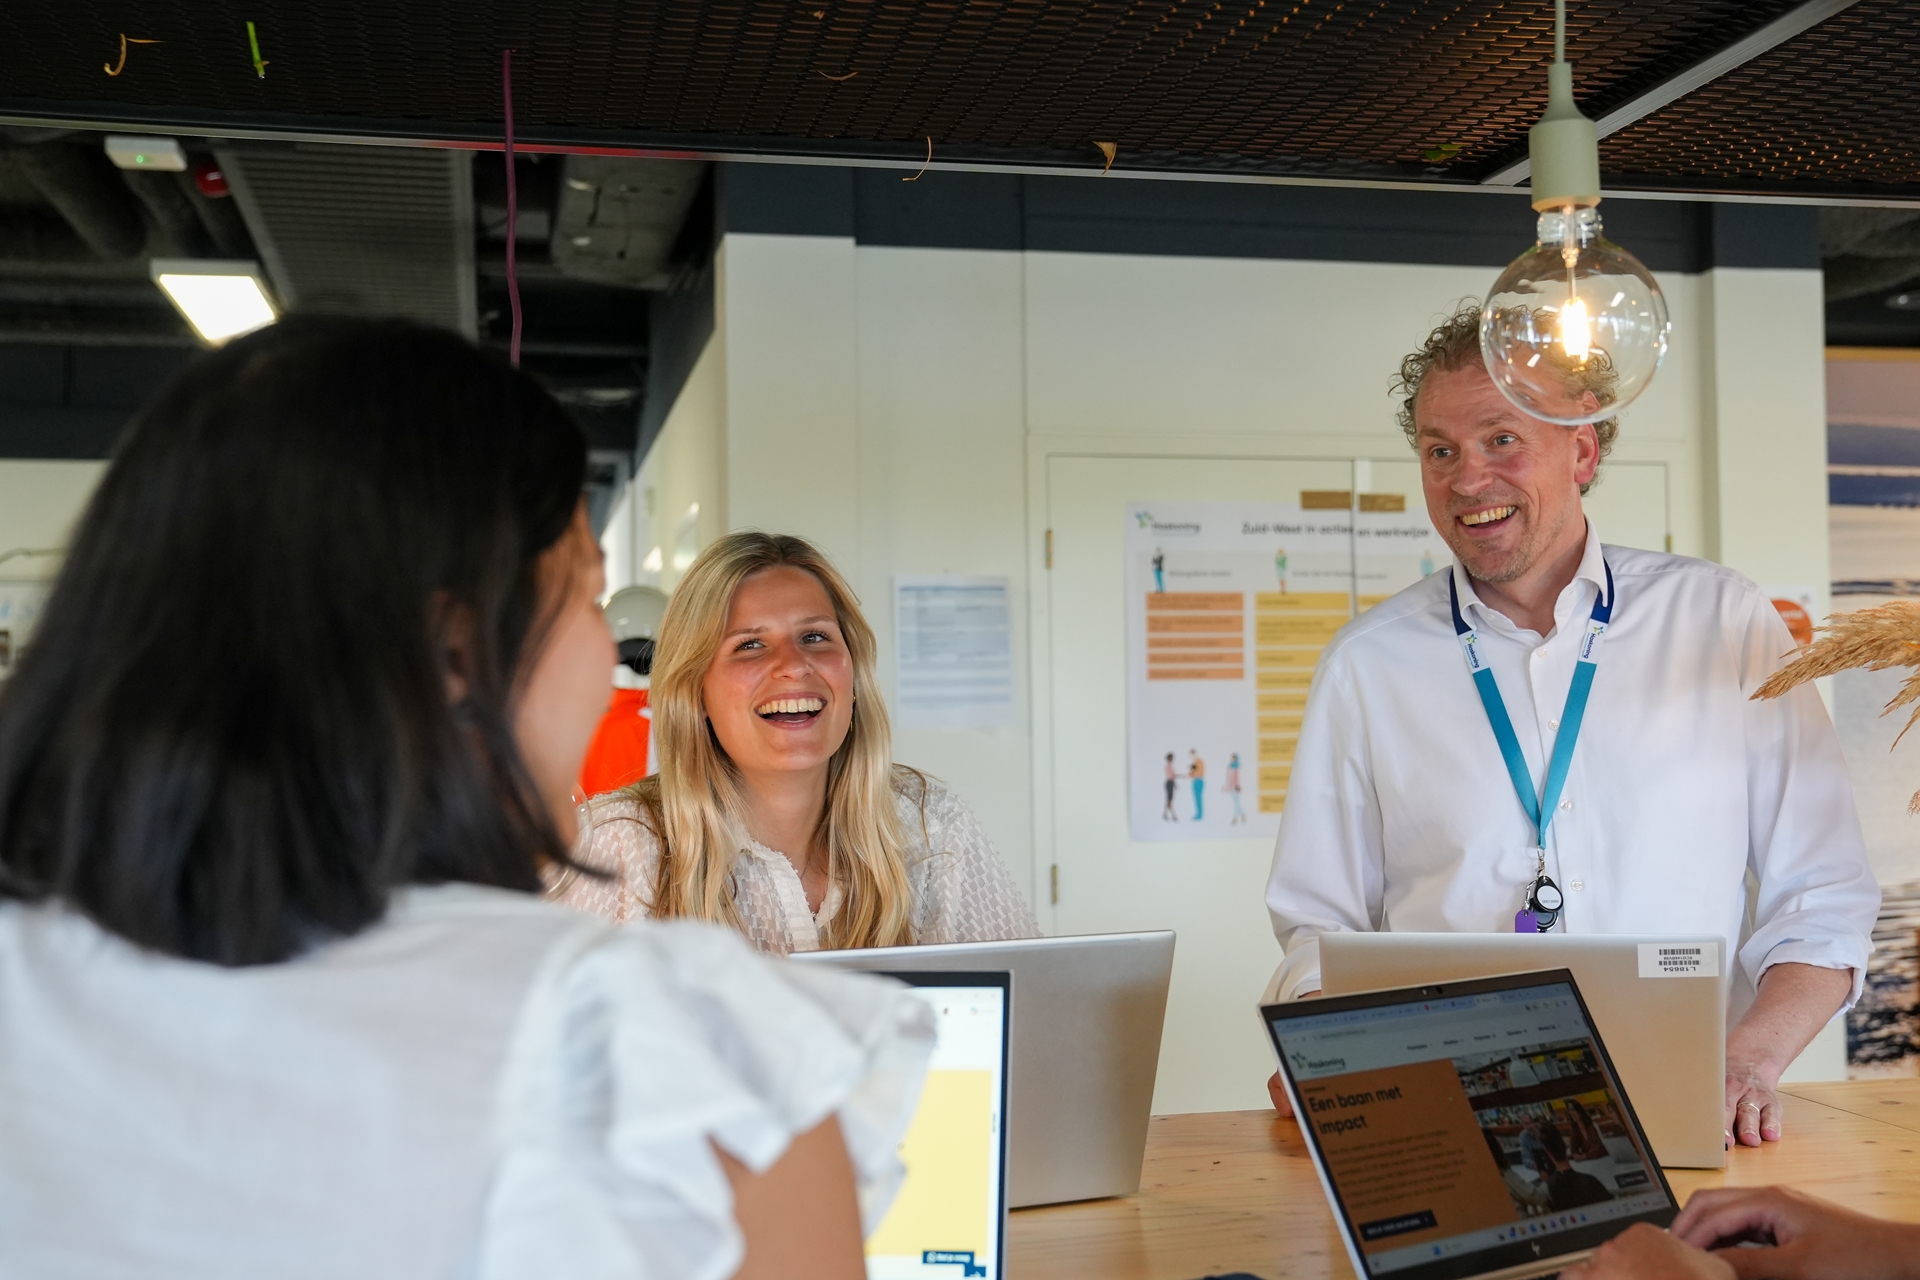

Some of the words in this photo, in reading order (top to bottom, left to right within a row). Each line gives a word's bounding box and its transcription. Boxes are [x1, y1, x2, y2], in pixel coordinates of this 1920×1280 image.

[1467, 643, 1479, 668] Haskoning
[1583, 632, 1596, 659] Haskoning
[1307, 1058, 1346, 1069] Haskoning
[1308, 1097, 1336, 1112] Een
[1336, 1091, 1374, 1108] baan
[1375, 1086, 1403, 1102] met
[1317, 1115, 1368, 1136] impact
